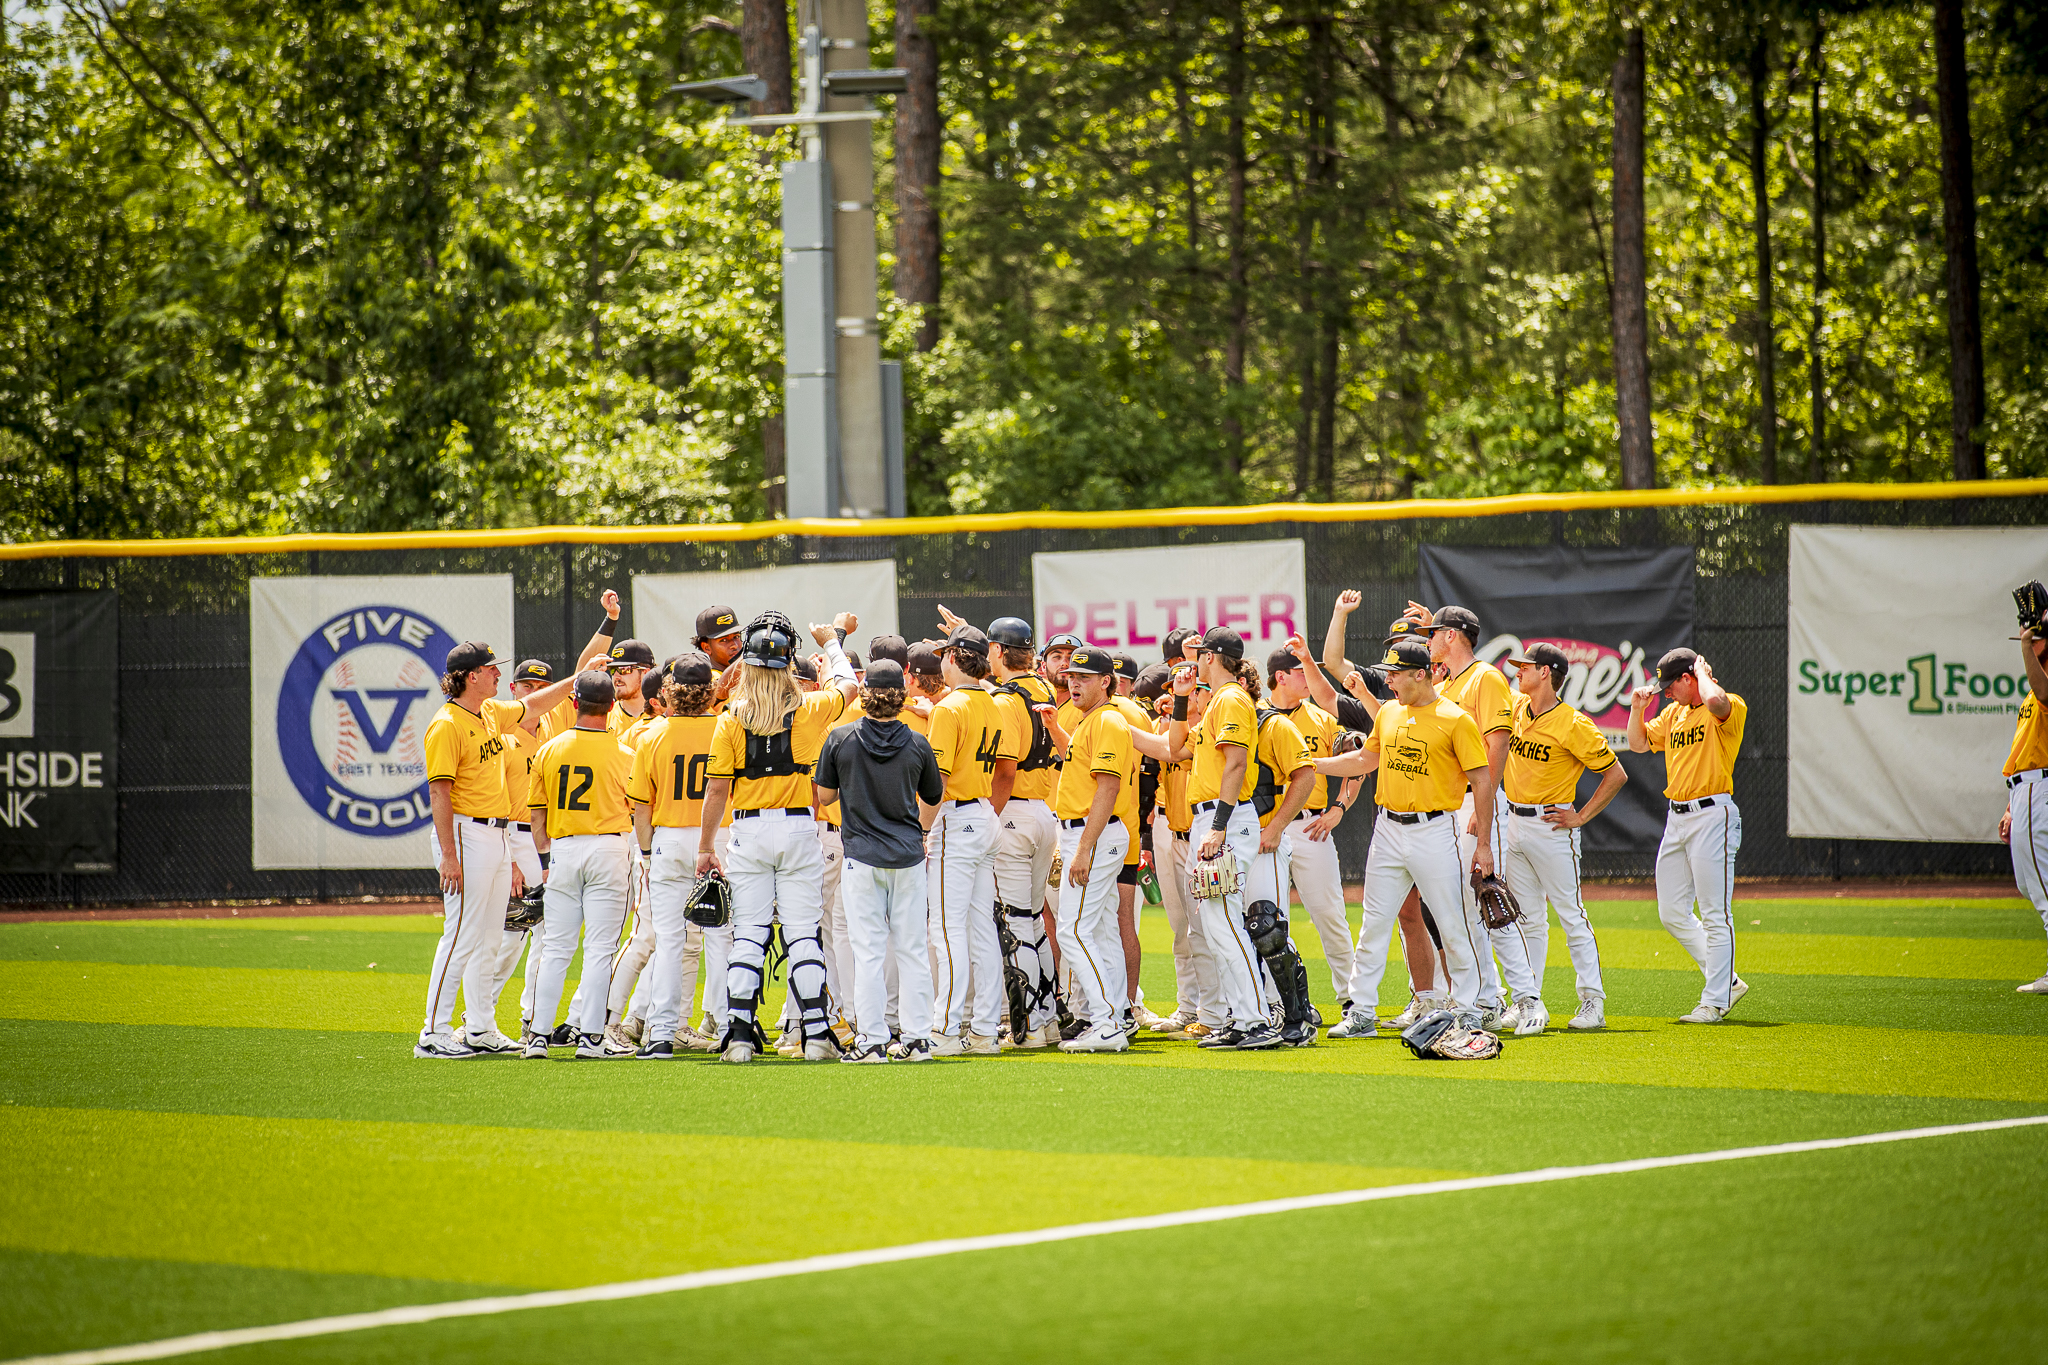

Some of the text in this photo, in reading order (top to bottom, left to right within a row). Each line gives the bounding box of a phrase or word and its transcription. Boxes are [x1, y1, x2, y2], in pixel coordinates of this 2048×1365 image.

[323, 609, 436, 654] FIVE
[1044, 593, 1297, 648] PELTIER
[1798, 660, 1905, 706] Super
[1907, 652, 1944, 715] 1
[1956, 702, 2004, 715] Discount
[337, 762, 425, 777] EAST TEXAS
[976, 726, 1002, 774] 44
[557, 764, 594, 811] 12
[673, 753, 710, 801] 10
